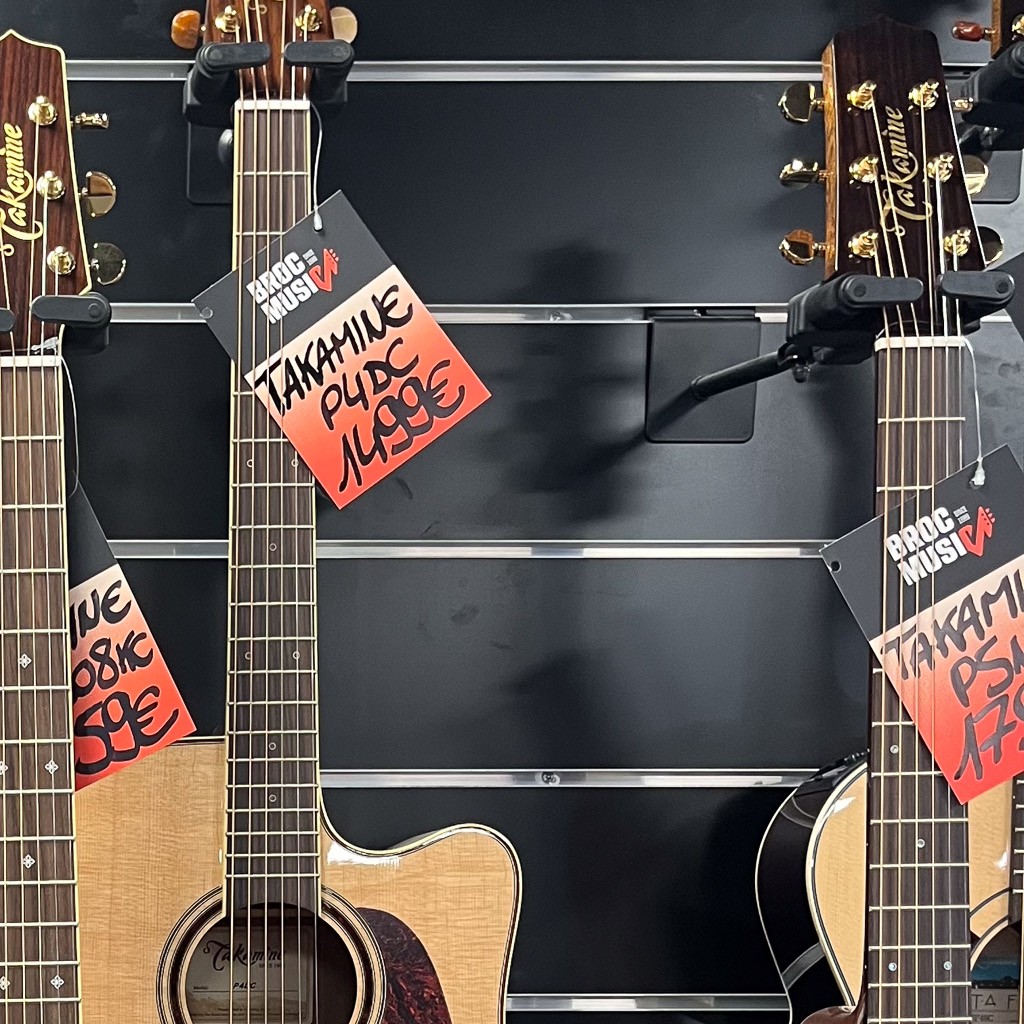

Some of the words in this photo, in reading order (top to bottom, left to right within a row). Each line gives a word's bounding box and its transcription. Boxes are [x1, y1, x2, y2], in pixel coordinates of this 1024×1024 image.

[880, 105, 933, 237] Takamine
[245, 251, 306, 305] BROC
[254, 284, 413, 417] TAKAMINE
[337, 359, 466, 493] 1499€
[885, 506, 956, 563] BROC
[880, 568, 1024, 681] TAKAMI
